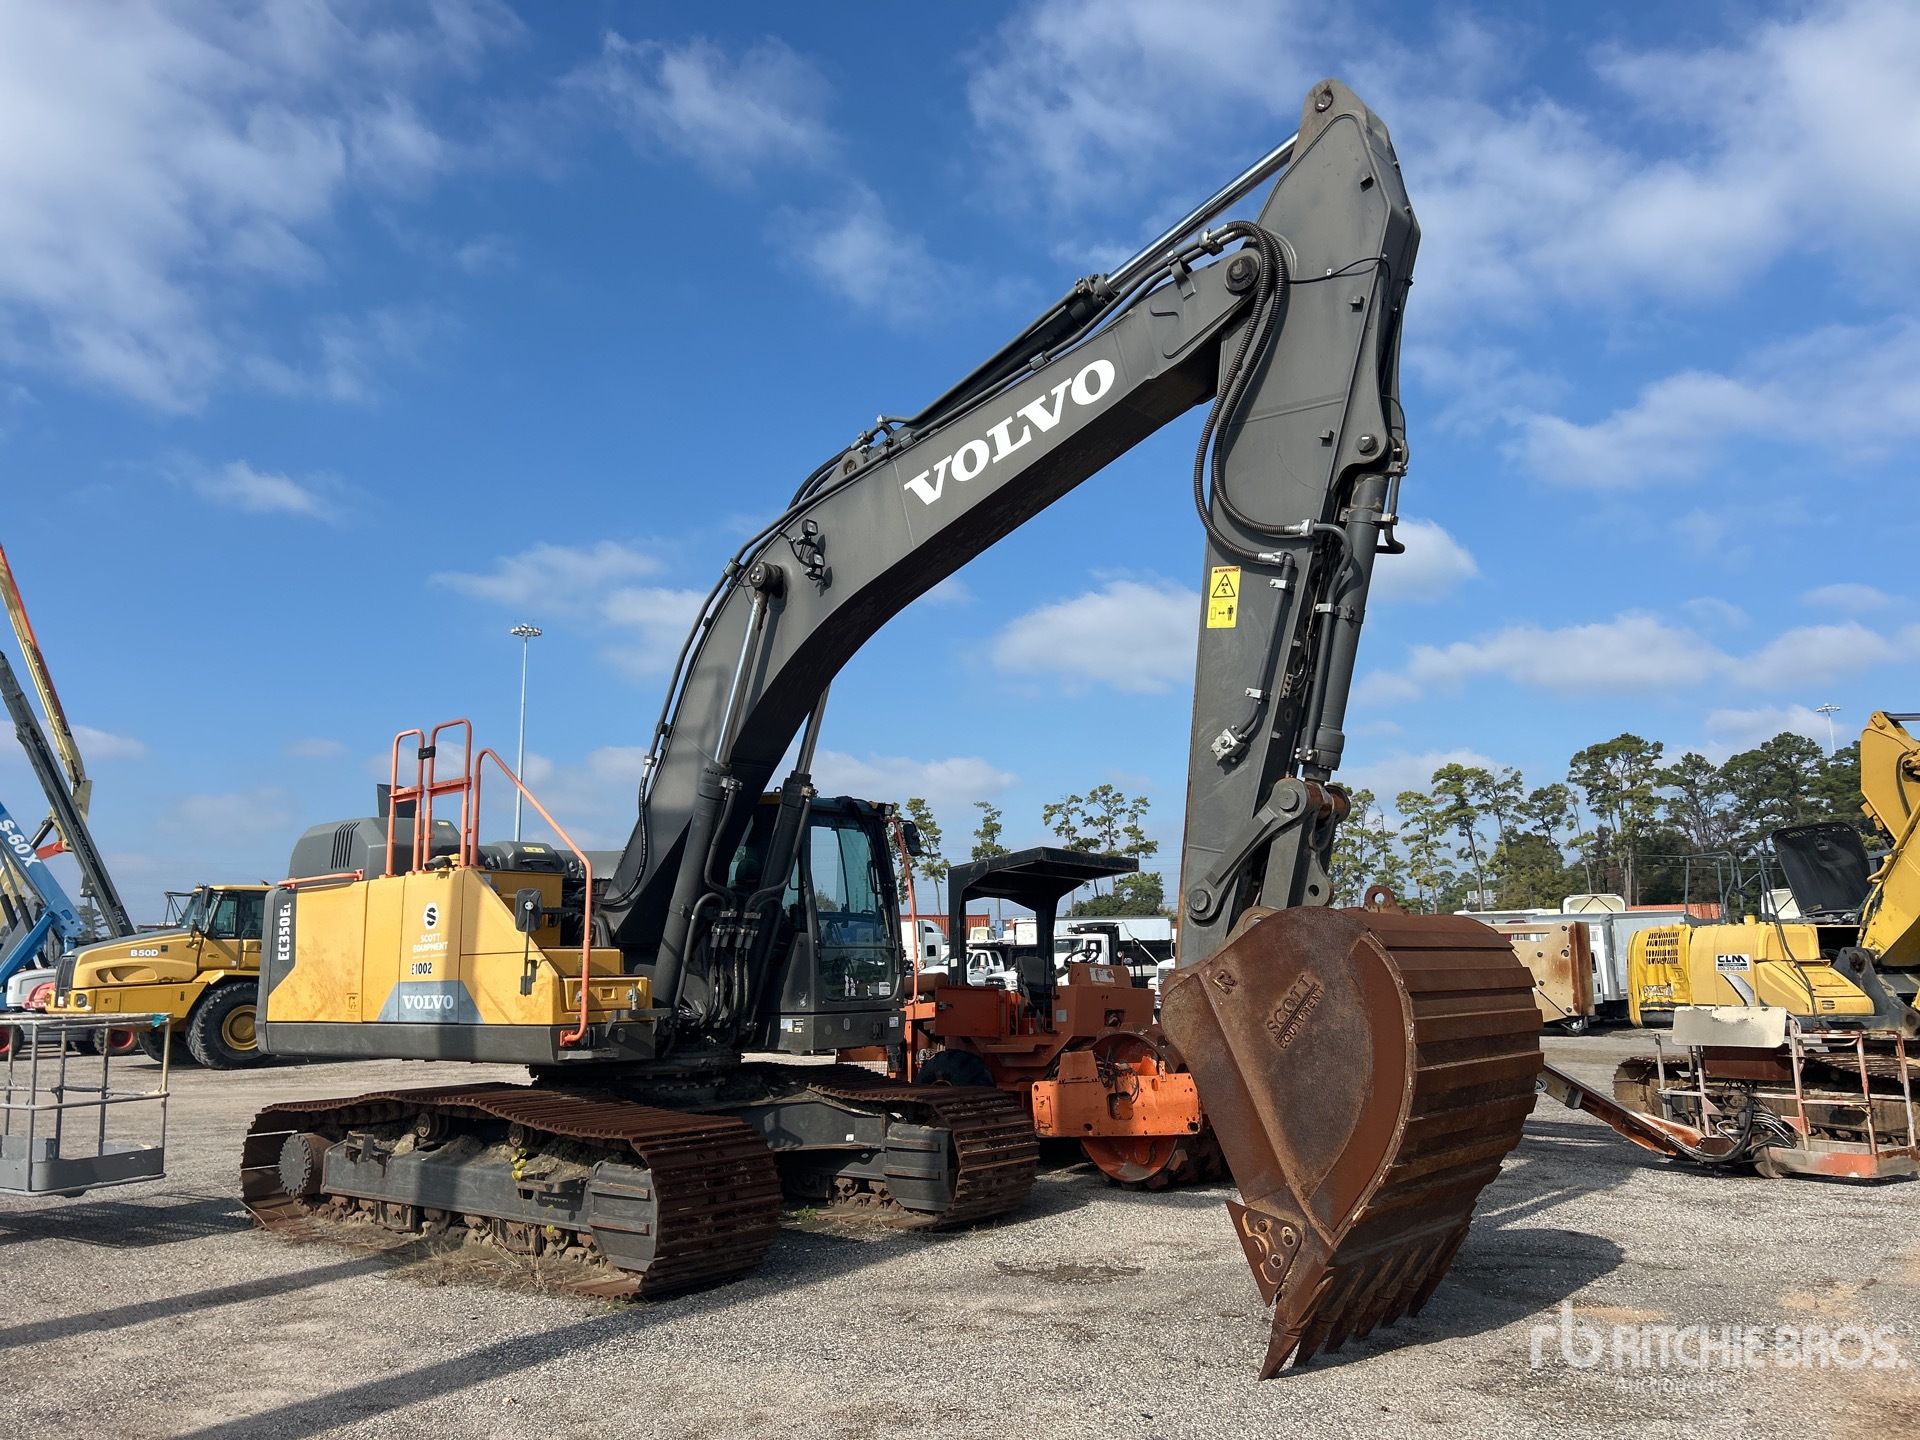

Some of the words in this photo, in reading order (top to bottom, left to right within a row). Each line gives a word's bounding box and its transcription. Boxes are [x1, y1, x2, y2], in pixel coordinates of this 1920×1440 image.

[904, 359, 1116, 505] VOLVO
[0, 819, 41, 868] S-60X
[420, 932, 441, 943] SCOTT
[130, 949, 159, 957] B50D
[412, 941, 448, 953] EQUIPMENT
[1717, 955, 1747, 963] CLM
[411, 962, 432, 975] E1002
[402, 994, 454, 1010] VOLVO
[1266, 974, 1312, 1036] SCOTT
[1279, 987, 1325, 1049] EQUIPMENT
